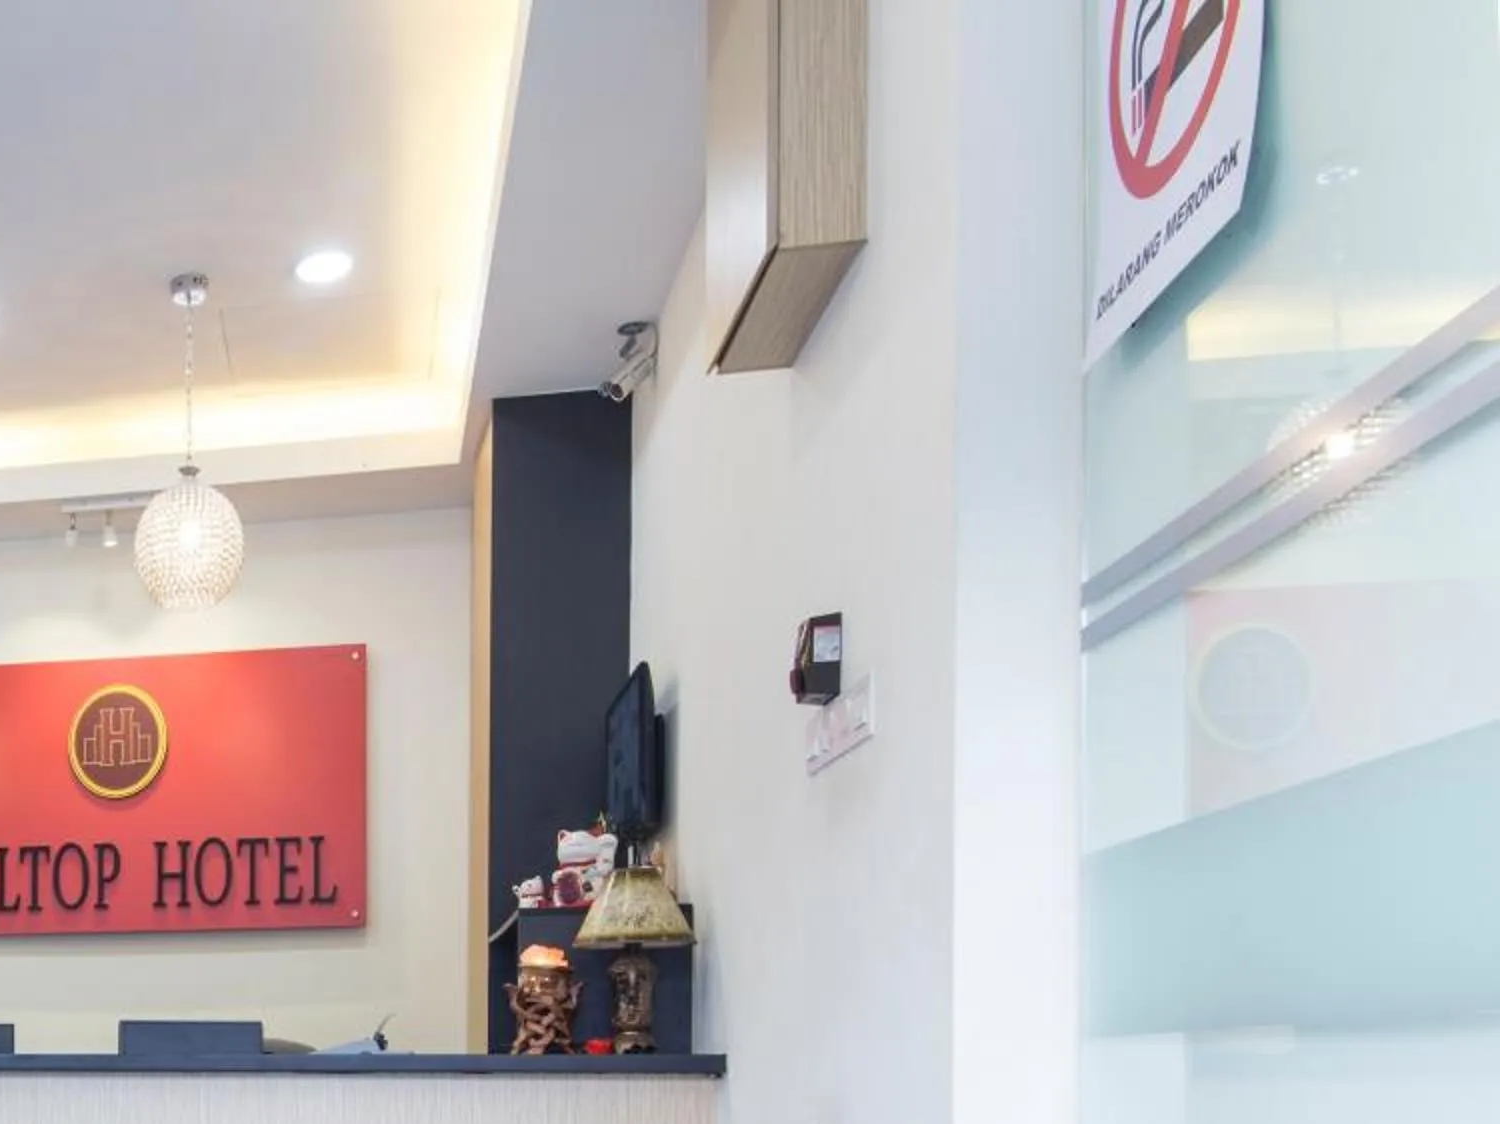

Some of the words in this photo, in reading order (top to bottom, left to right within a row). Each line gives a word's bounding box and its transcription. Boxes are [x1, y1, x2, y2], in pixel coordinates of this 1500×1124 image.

[1096, 229, 1162, 321] DILARANG
[1163, 139, 1241, 246] MEROKOK
[152, 835, 339, 909] HOTEL
